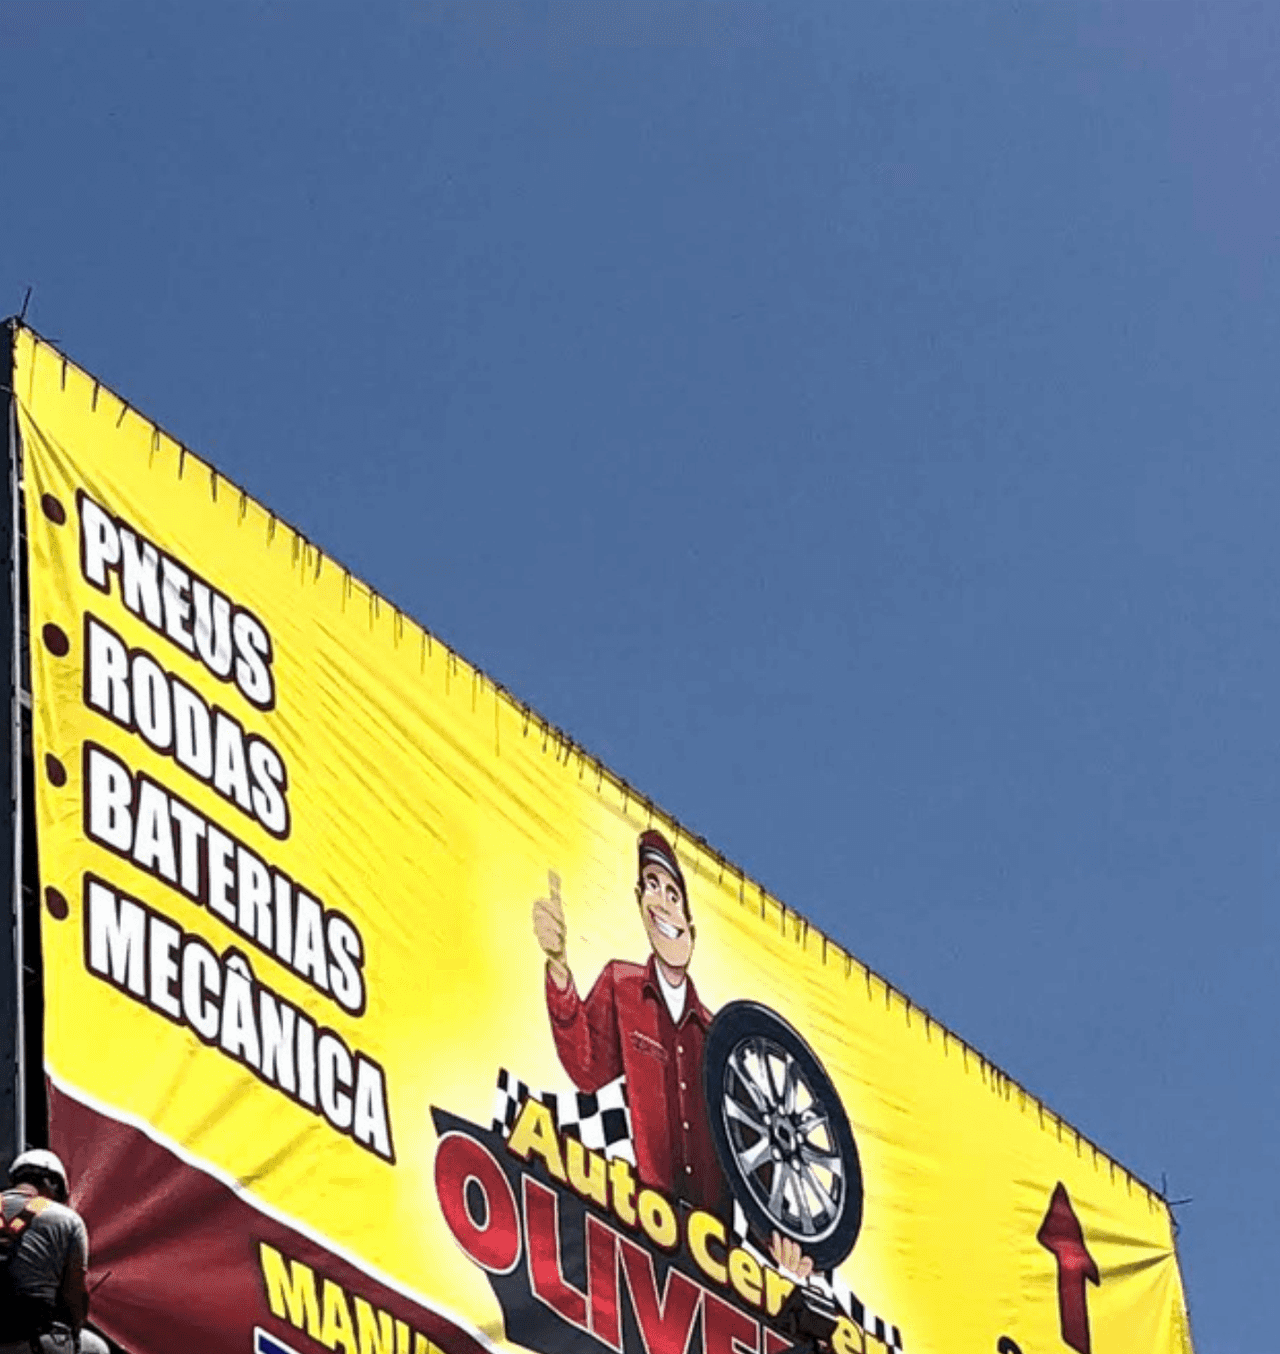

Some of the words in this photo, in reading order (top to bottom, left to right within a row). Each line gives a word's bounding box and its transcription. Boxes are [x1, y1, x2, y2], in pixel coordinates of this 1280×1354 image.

[76, 488, 275, 712] PNEUS
[83, 611, 290, 840] RODAS
[83, 740, 366, 1017] BATERIAS
[83, 871, 396, 1166] MECÂNICA
[508, 1097, 678, 1249] Auto
